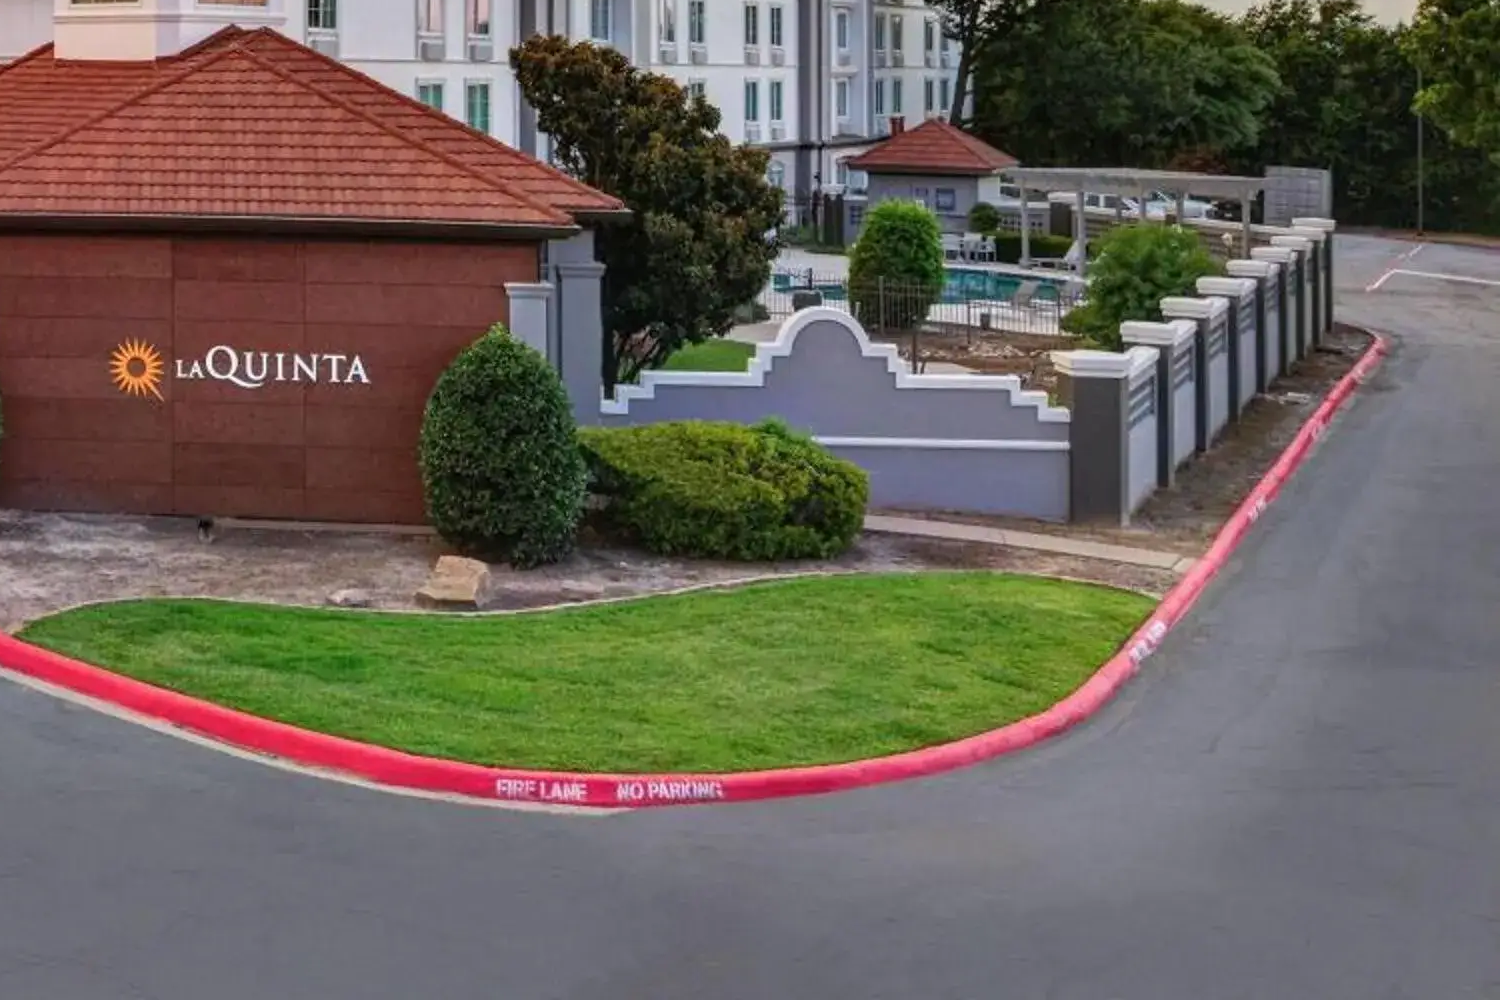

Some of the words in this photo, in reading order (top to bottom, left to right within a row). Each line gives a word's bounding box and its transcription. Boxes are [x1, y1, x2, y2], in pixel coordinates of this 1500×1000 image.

[205, 345, 371, 388] QUINTA
[496, 779, 536, 797] FIRE
[540, 783, 588, 800] LANE
[617, 783, 644, 800] NO
[650, 781, 724, 799] PARKING
